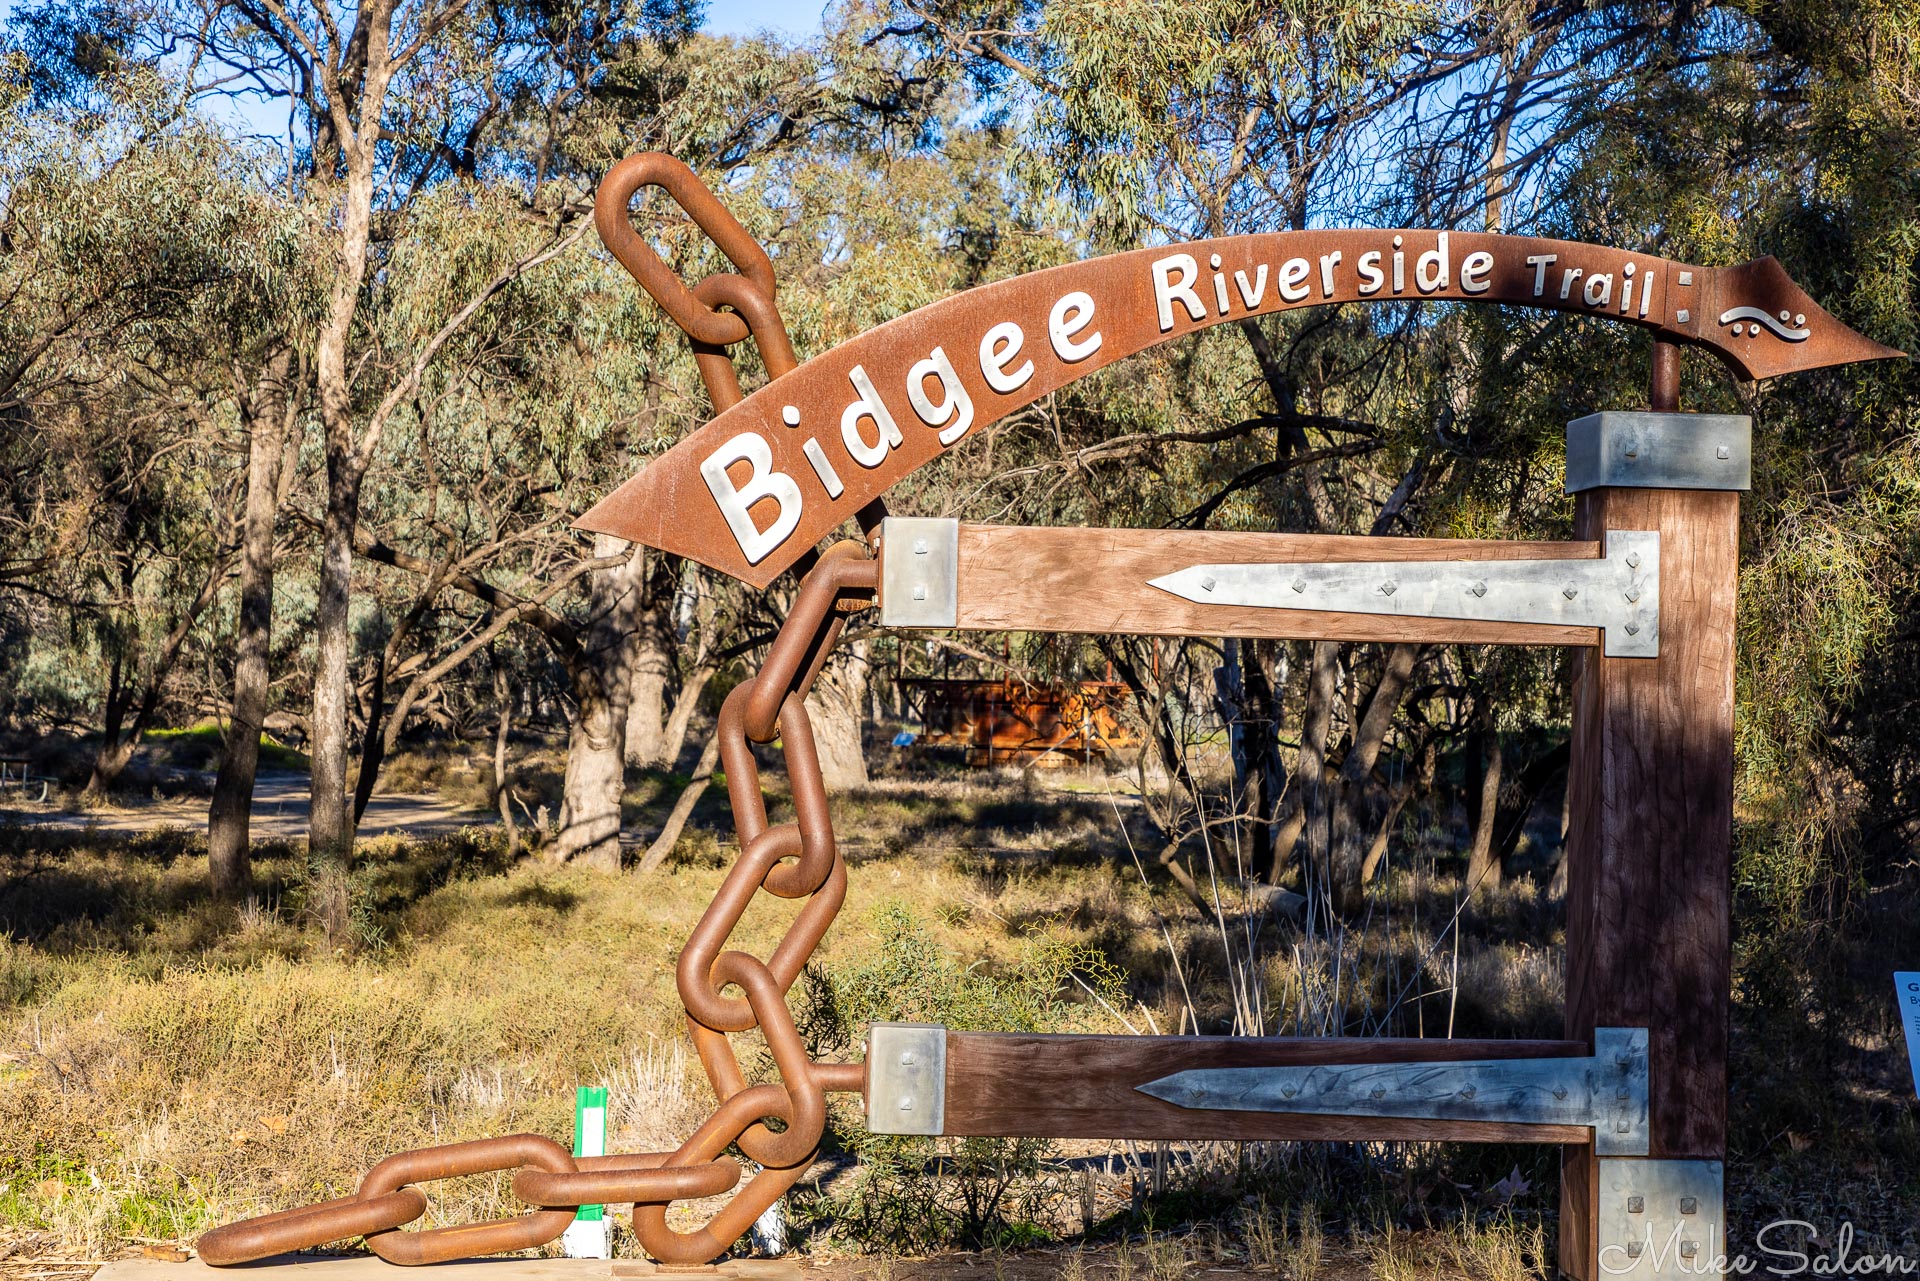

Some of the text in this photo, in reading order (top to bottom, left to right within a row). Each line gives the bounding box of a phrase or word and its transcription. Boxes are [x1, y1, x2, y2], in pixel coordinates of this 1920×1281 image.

[700, 231, 1655, 564] Bidgee Riverside Trail
